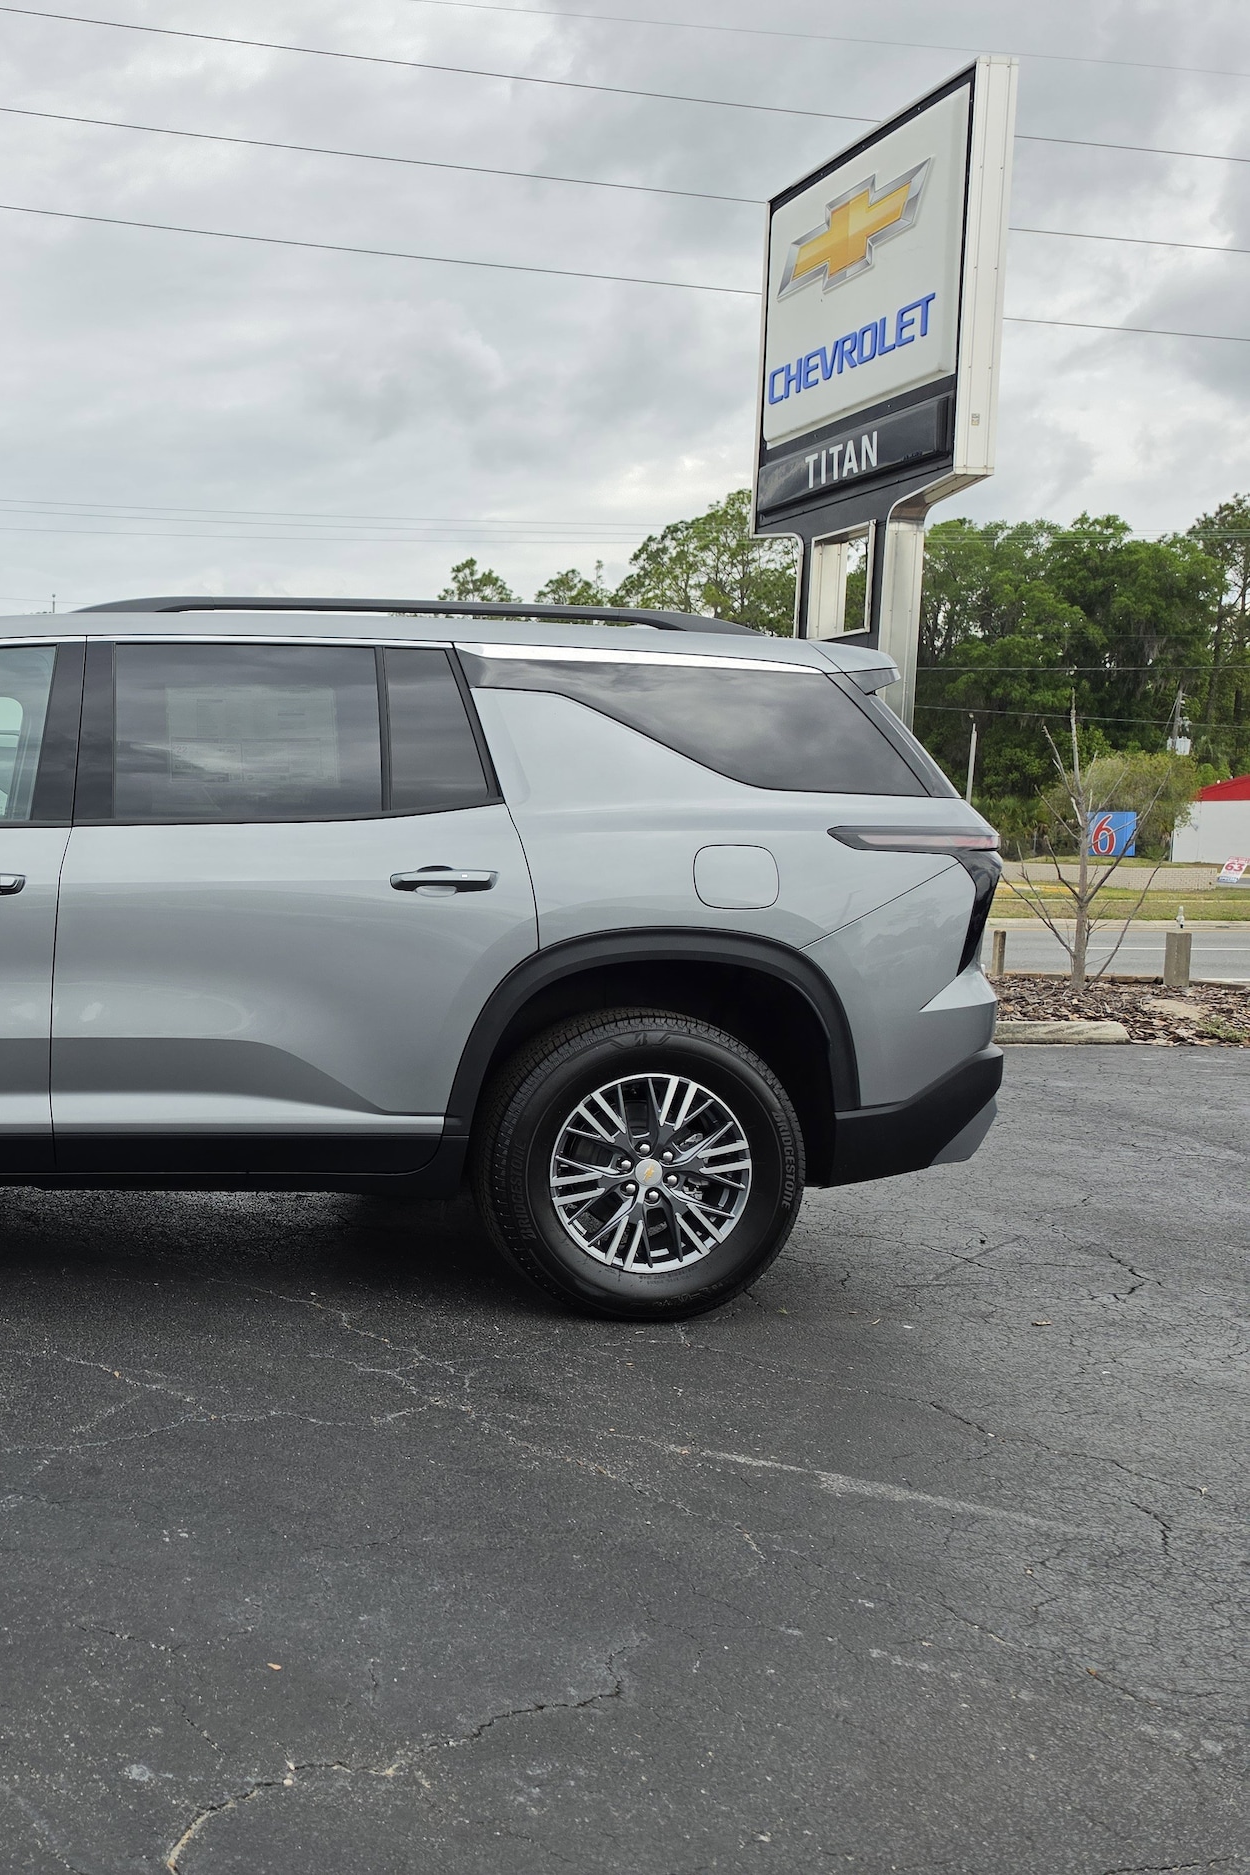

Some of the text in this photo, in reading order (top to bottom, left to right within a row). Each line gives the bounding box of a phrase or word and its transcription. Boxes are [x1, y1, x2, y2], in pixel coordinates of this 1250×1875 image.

[768, 292, 936, 405] CHEVROLET
[805, 431, 878, 489] TITAN
[1091, 814, 1116, 856] 6
[1225, 862, 1244, 871] 63
[510, 1143, 537, 1240] BRIDGESTONE
[772, 1111, 796, 1209] BRIDGESTONE
